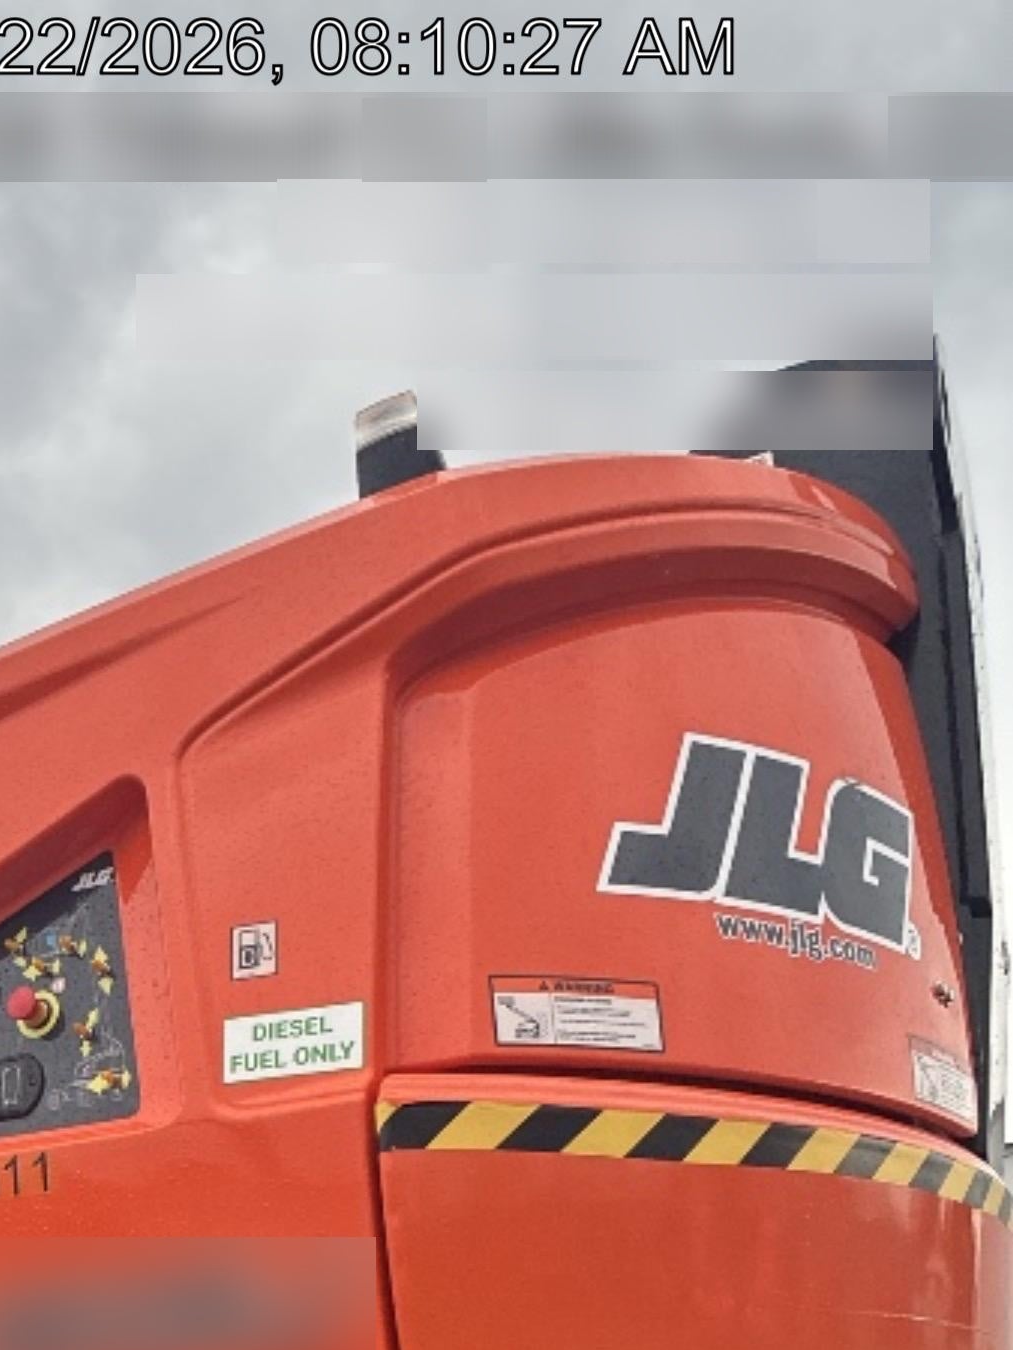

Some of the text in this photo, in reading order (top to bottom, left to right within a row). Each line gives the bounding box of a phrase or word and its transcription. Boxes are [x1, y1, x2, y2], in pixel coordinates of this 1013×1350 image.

[596, 731, 913, 954] JLG
[714, 913, 877, 969] www.jlg.com
[252, 1015, 334, 1042] DIESEL
[229, 1039, 355, 1075] FUEL ONLY
